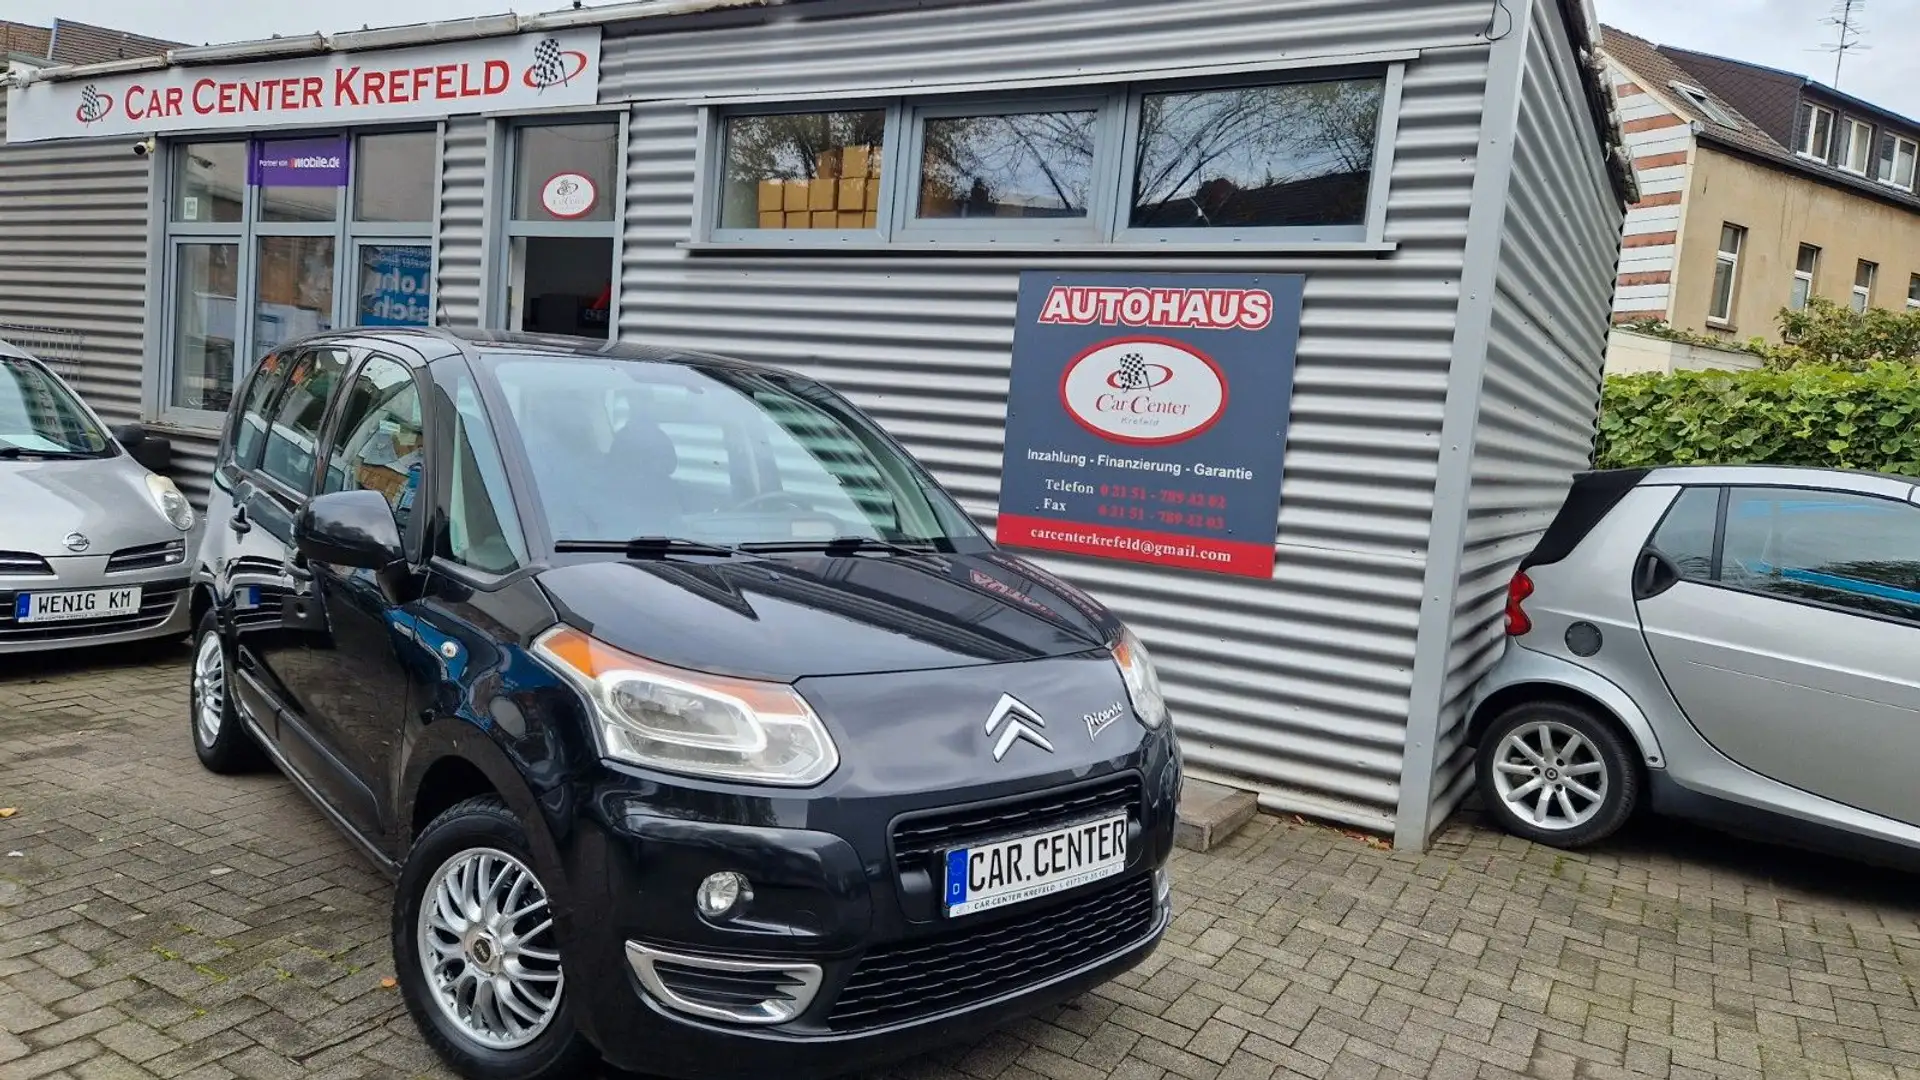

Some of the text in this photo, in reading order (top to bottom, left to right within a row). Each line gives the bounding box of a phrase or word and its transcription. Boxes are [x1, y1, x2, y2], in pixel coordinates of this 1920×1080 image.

[124, 60, 510, 120] CAR CENTER KREFELD
[1038, 286, 1273, 330] AUTOHAUS
[1095, 393, 1190, 415] Car Center
[1027, 448, 1086, 466] Inzahlung
[1097, 454, 1182, 476] Finanzierung
[1194, 463, 1253, 480] Garantie
[1045, 478, 1094, 494] Telefon
[1043, 498, 1067, 511] Fax
[1030, 527, 1232, 562] carcenterkrefeld@gmail.com
[38, 591, 131, 614] WENIG KM
[968, 819, 1126, 892] CAR.CENTER
[953, 882, 960, 895] D
